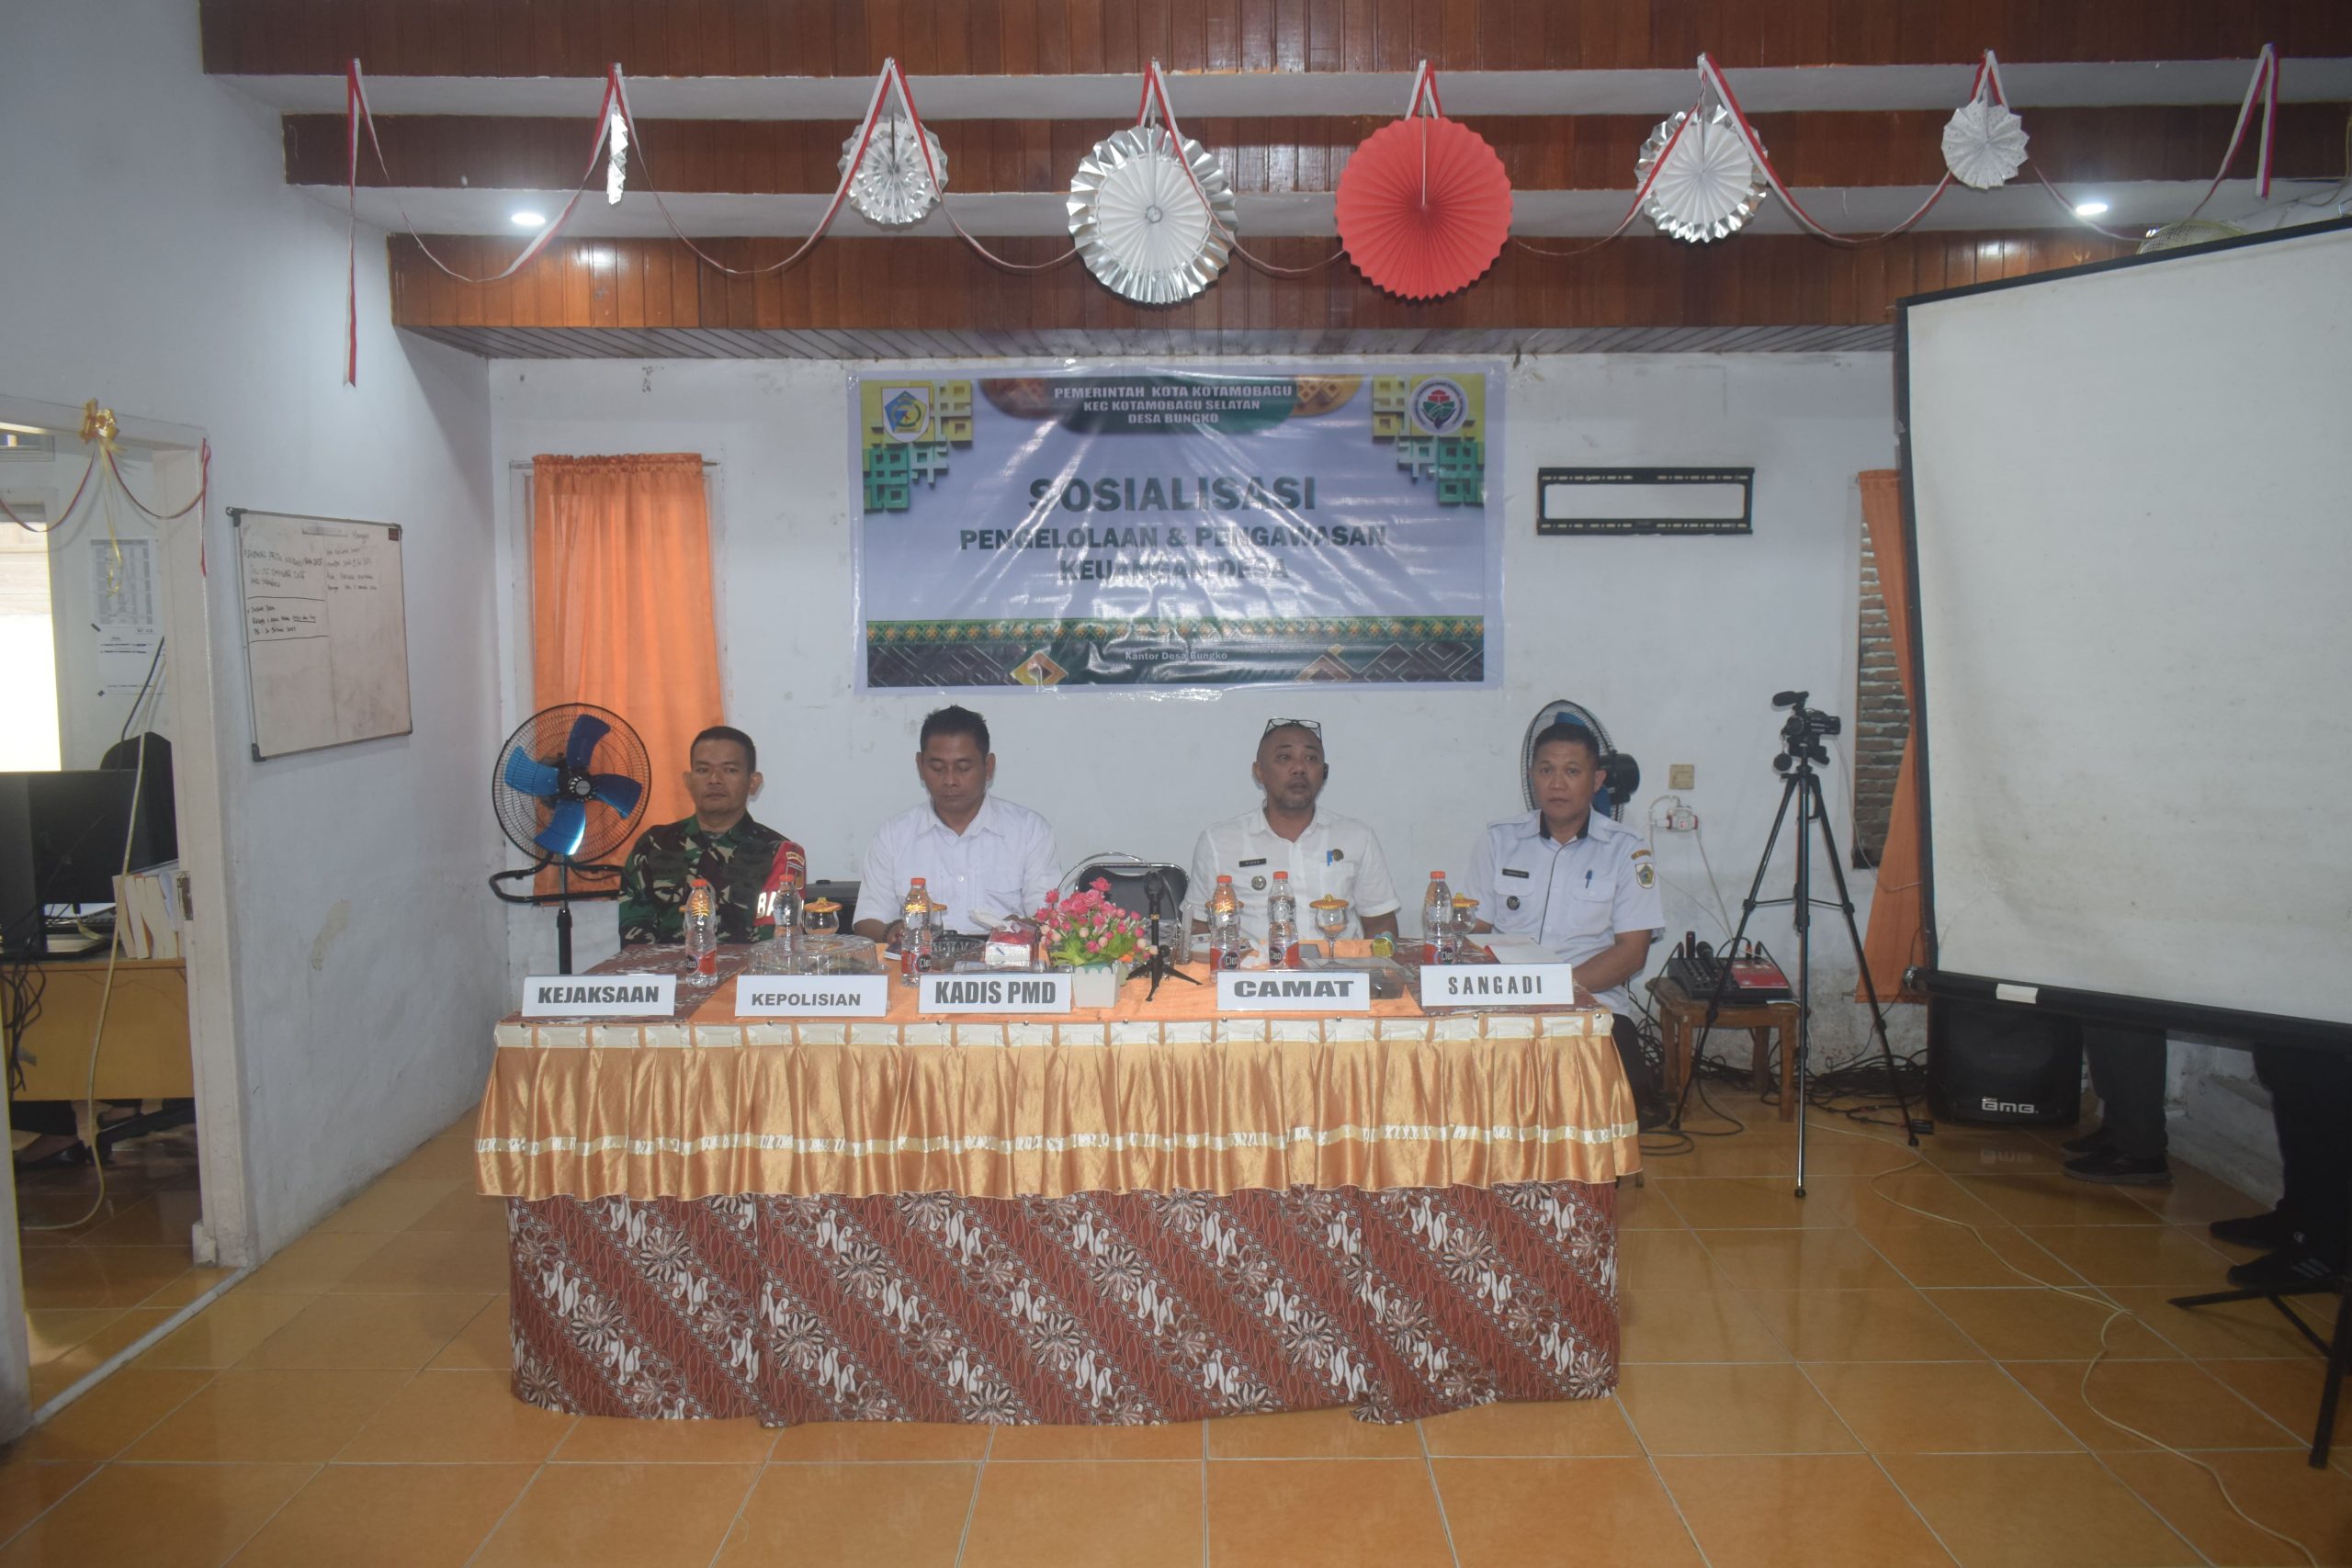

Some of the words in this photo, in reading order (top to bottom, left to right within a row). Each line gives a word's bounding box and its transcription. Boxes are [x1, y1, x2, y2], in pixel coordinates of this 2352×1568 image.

[1054, 386, 1146, 399] PEMERINTAH
[1151, 386, 1189, 398] KOTA
[1192, 385, 1294, 398] KOTAMOBAGU
[1083, 400, 1109, 412] KEC
[1111, 400, 1203, 412] KOTAMOBAGU
[1204, 399, 1261, 411] SELATAN
[1128, 413, 1162, 424] DESA
[1164, 413, 1220, 424] BUNGKO
[1028, 476, 1316, 513] SOSIALISASI
[959, 526, 1159, 550] PENGELOLAAN
[1166, 525, 1187, 548] &
[1195, 525, 1386, 547] PENGAWASAN
[1059, 558, 1210, 581] KEUANGAN
[1217, 557, 1290, 580] DESA
[1125, 651, 1159, 661] Kantor
[1161, 651, 1187, 660] Desa
[1189, 651, 1228, 661] Bungko
[934, 980, 1002, 1005] KADIS
[1007, 980, 1057, 1004] PMD
[1233, 979, 1355, 998] CAMAT
[1447, 975, 1543, 996] SANGADI
[537, 986, 660, 1005] KEJAKSAAN
[751, 992, 862, 1007] KEPOLISIAN
